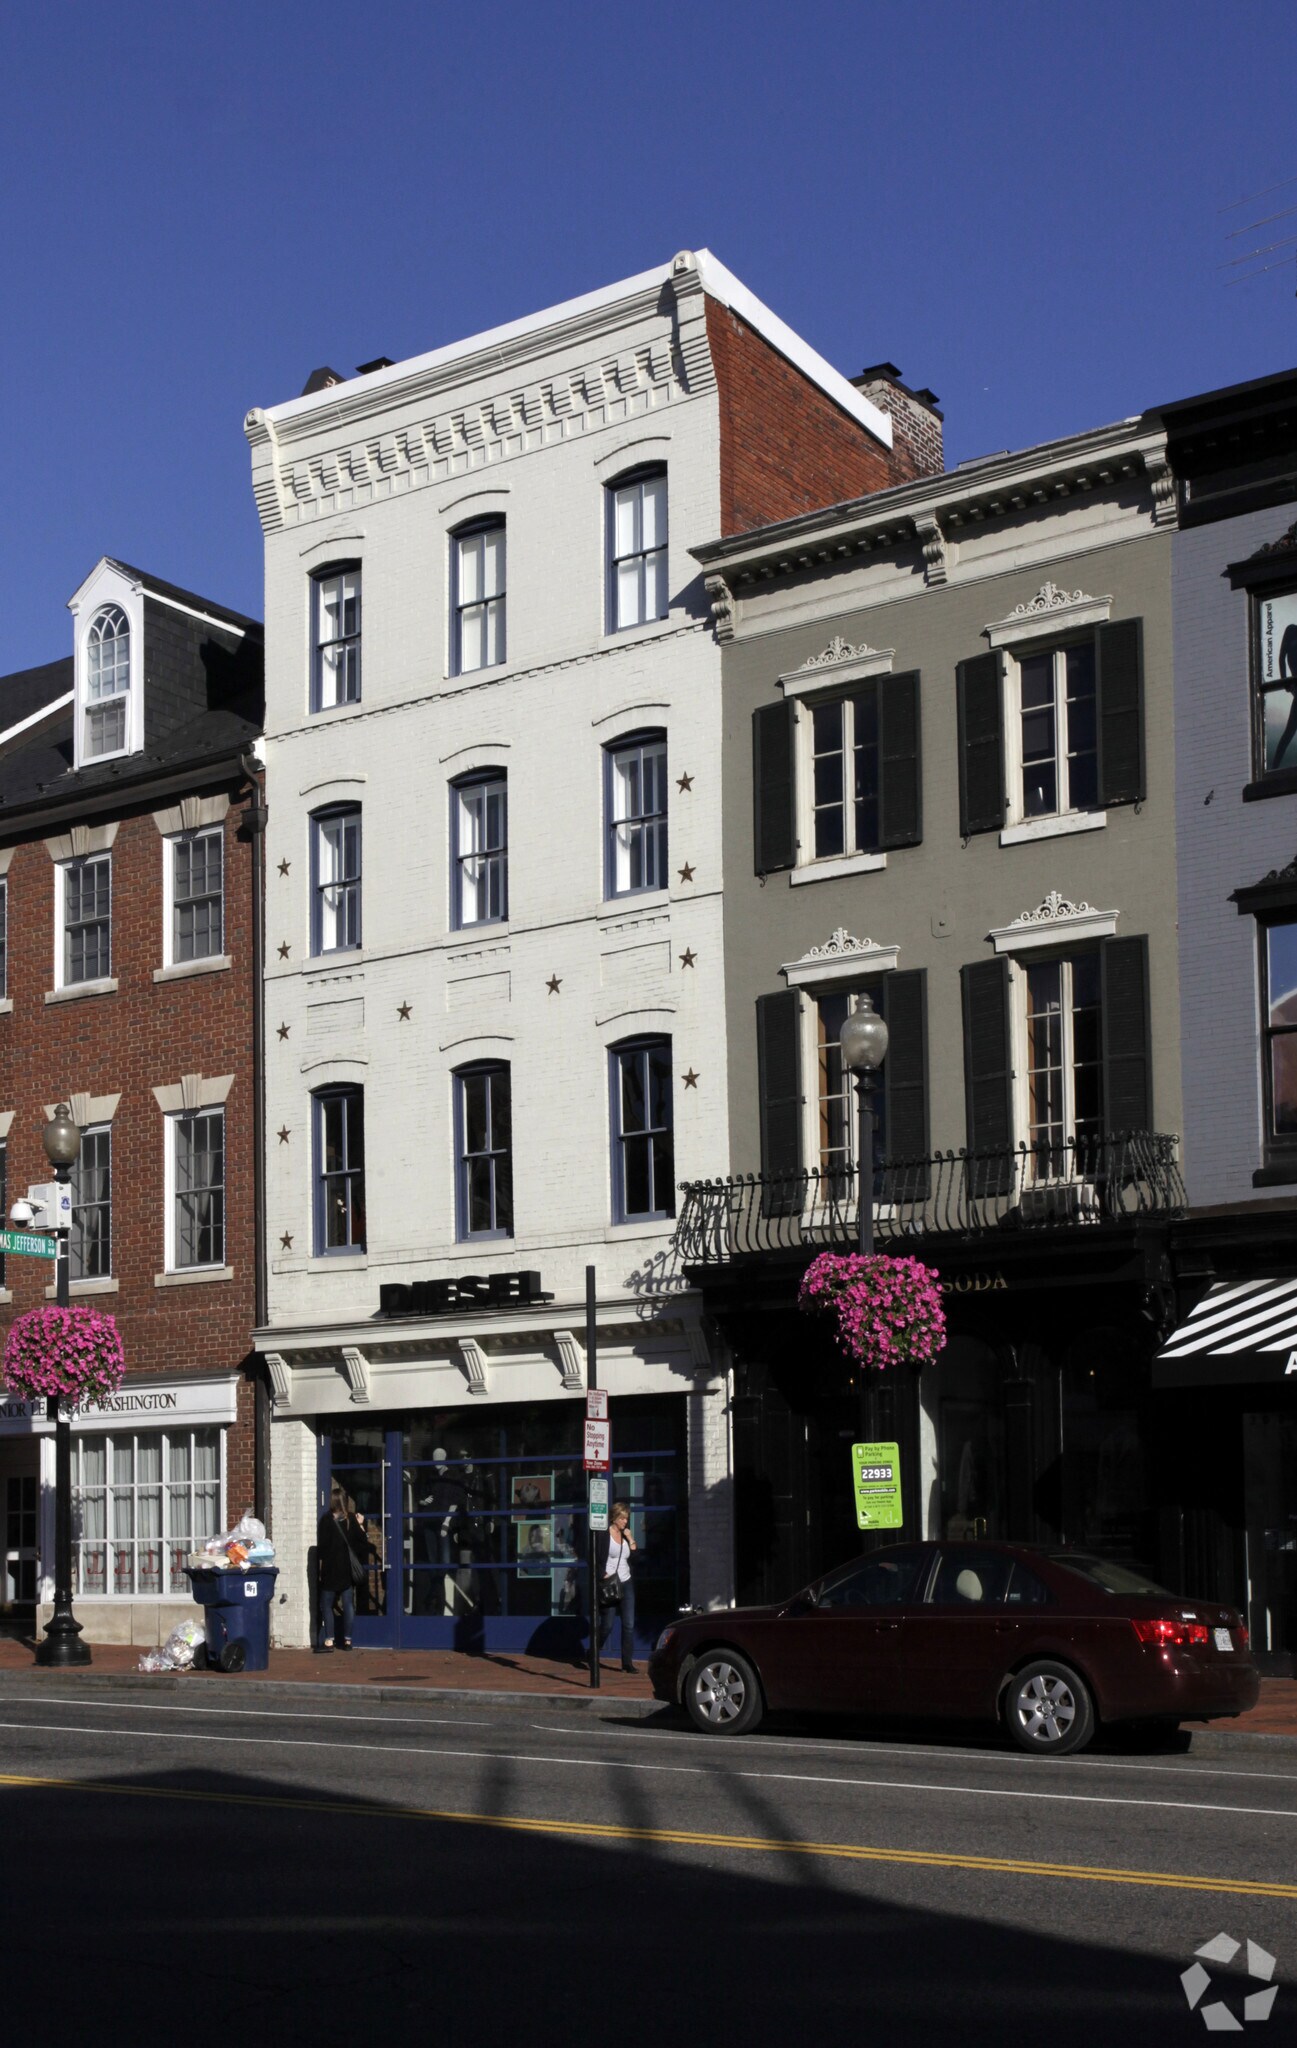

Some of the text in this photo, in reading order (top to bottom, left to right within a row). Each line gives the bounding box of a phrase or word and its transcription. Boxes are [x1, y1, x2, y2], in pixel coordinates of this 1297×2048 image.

[1265, 603, 1273, 678] American Apparel
[12, 1235, 46, 1254] JEFFERSON
[47, 1247, 55, 1255] NW
[942, 1270, 1009, 1293] SODA
[380, 1270, 555, 1314] DIESEL
[96, 1393, 177, 1412] WASHINGTON
[587, 1423, 596, 1431] No
[586, 1431, 605, 1441] Stopping
[586, 1440, 605, 1449] Anytime
[862, 1468, 892, 1479] 22933
